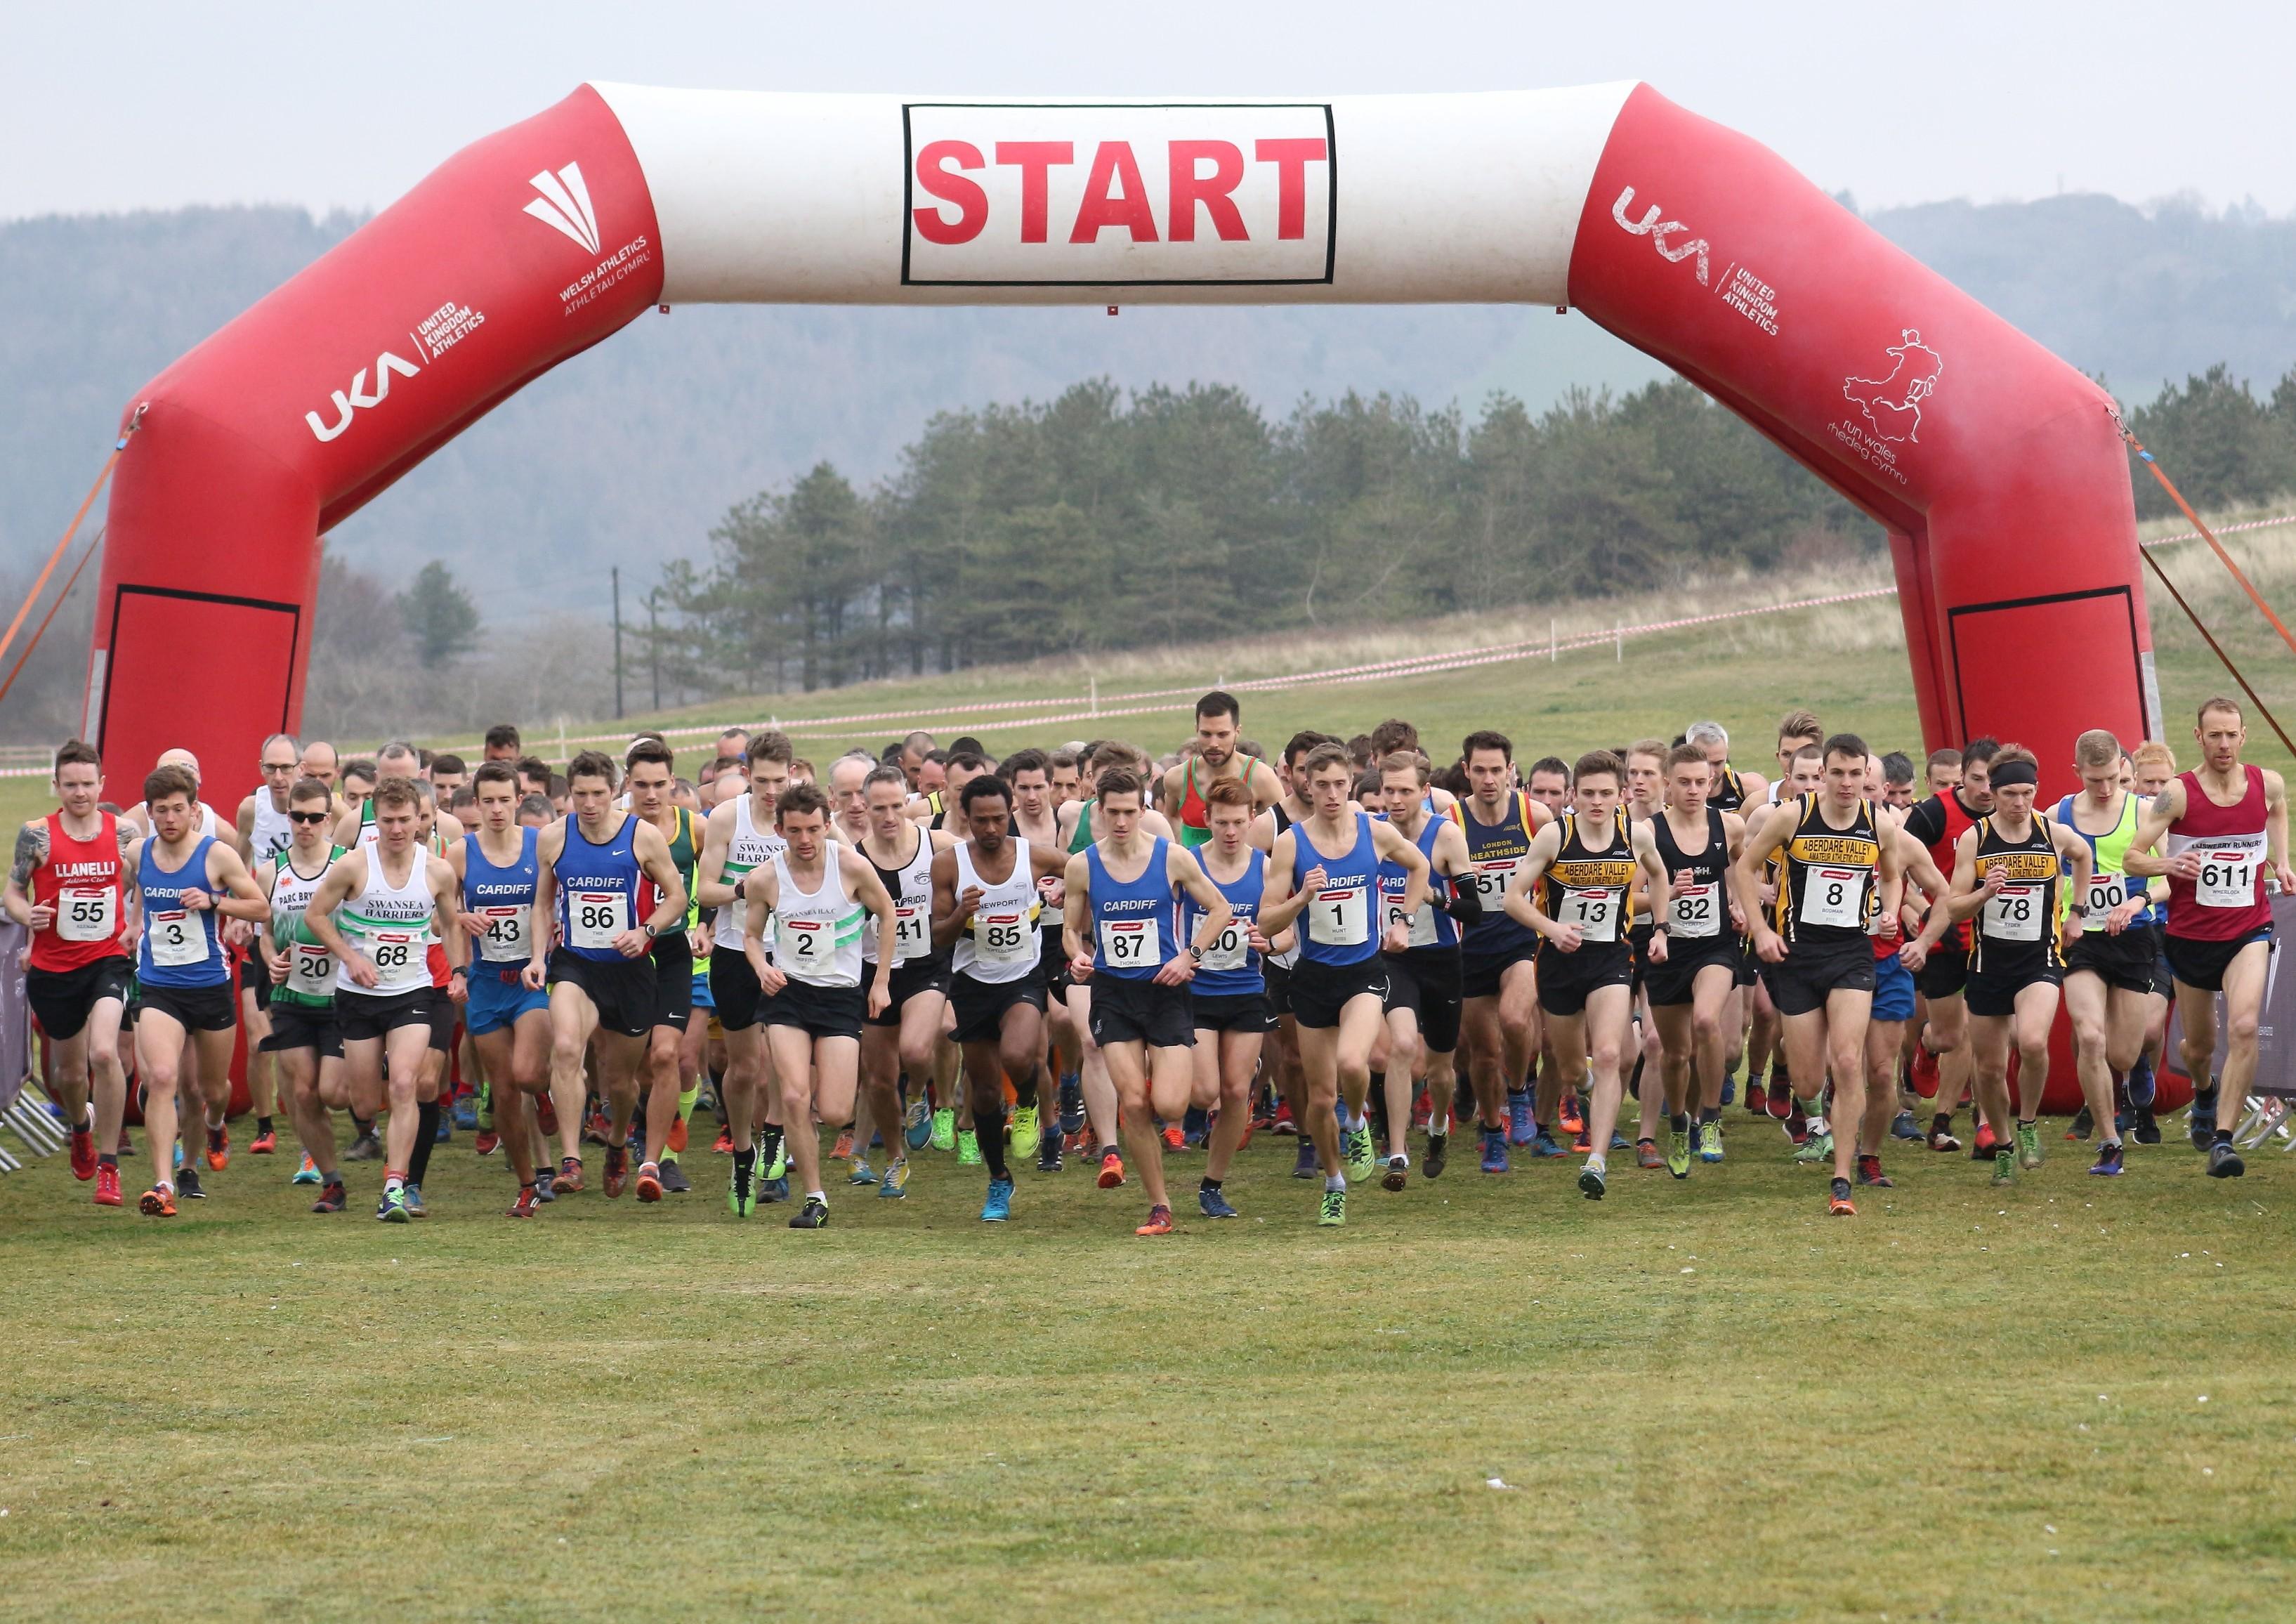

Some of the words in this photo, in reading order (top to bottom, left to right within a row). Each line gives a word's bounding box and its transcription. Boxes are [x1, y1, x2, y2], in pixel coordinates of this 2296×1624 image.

[913, 138, 1327, 245] START
[1612, 185, 1710, 287] UKA
[559, 271, 596, 302] WELSH
[596, 235, 647, 278] ATHLETICS
[565, 275, 615, 317] ATHLETAU
[616, 249, 650, 280] CYMRU
[1736, 268, 1776, 301] UNITED
[1729, 279, 1778, 320] KINGDOM
[417, 301, 456, 335] UNITED
[1722, 291, 1778, 336] ATHLETICS
[424, 306, 472, 347] KINGDOM
[431, 311, 485, 359] ATHLETICS
[304, 351, 421, 443] UKA
[1842, 420, 1862, 440] run
[1864, 434, 1896, 464] wales
[1827, 422, 1870, 460] rhedeg
[1871, 454, 1908, 485] cymru
[739, 844, 787, 853] SWANSE
[1470, 846, 1527, 861] HEATHSIDE
[1482, 839, 1512, 849] LONDON
[1803, 839, 1844, 853] ABERDARE
[1845, 840, 1871, 856] VALLEY
[2233, 839, 2262, 849] RUNNERS
[737, 853, 770, 863] HARR
[1809, 852, 1831, 862] AMATEUR
[1832, 853, 1853, 863] ATHLETIC
[1854, 855, 1865, 863] CLUB
[2023, 856, 2049, 869] VALLEY
[55, 861, 115, 877] LLANELLI
[1564, 863, 1602, 877] ABERDARE
[1603, 863, 1629, 876] VALLEY
[2202, 864, 2248, 887] 611
[477, 884, 532, 895] CARDIFF
[567, 876, 624, 888] CARDIFF
[1325, 874, 1366, 889] ARDIFF
[1477, 872, 1516, 894] 51
[279, 893, 296, 905] PARC
[299, 891, 315, 901] BRY
[367, 899, 424, 910] SWANSEA
[894, 894, 926, 908] YPRIDD
[978, 898, 1019, 910] NEWPORT
[1103, 899, 1158, 912] CARDIFF
[1826, 883, 1843, 906] 8
[2090, 886, 2123, 910] 00
[71, 902, 105, 923] 55
[365, 909, 425, 919] HARRIERS
[581, 906, 615, 929] 86
[1331, 903, 1343, 926] 1
[1576, 901, 1607, 923] 13
[1677, 898, 1710, 920] 82
[1997, 898, 2031, 921] 78
[166, 924, 185, 945] 3
[487, 919, 520, 942] 43
[987, 925, 1021, 948] 85
[797, 933, 814, 956] 2
[1113, 934, 1145, 959] 87
[299, 956, 330, 978] 20
[375, 945, 408, 967] 68
